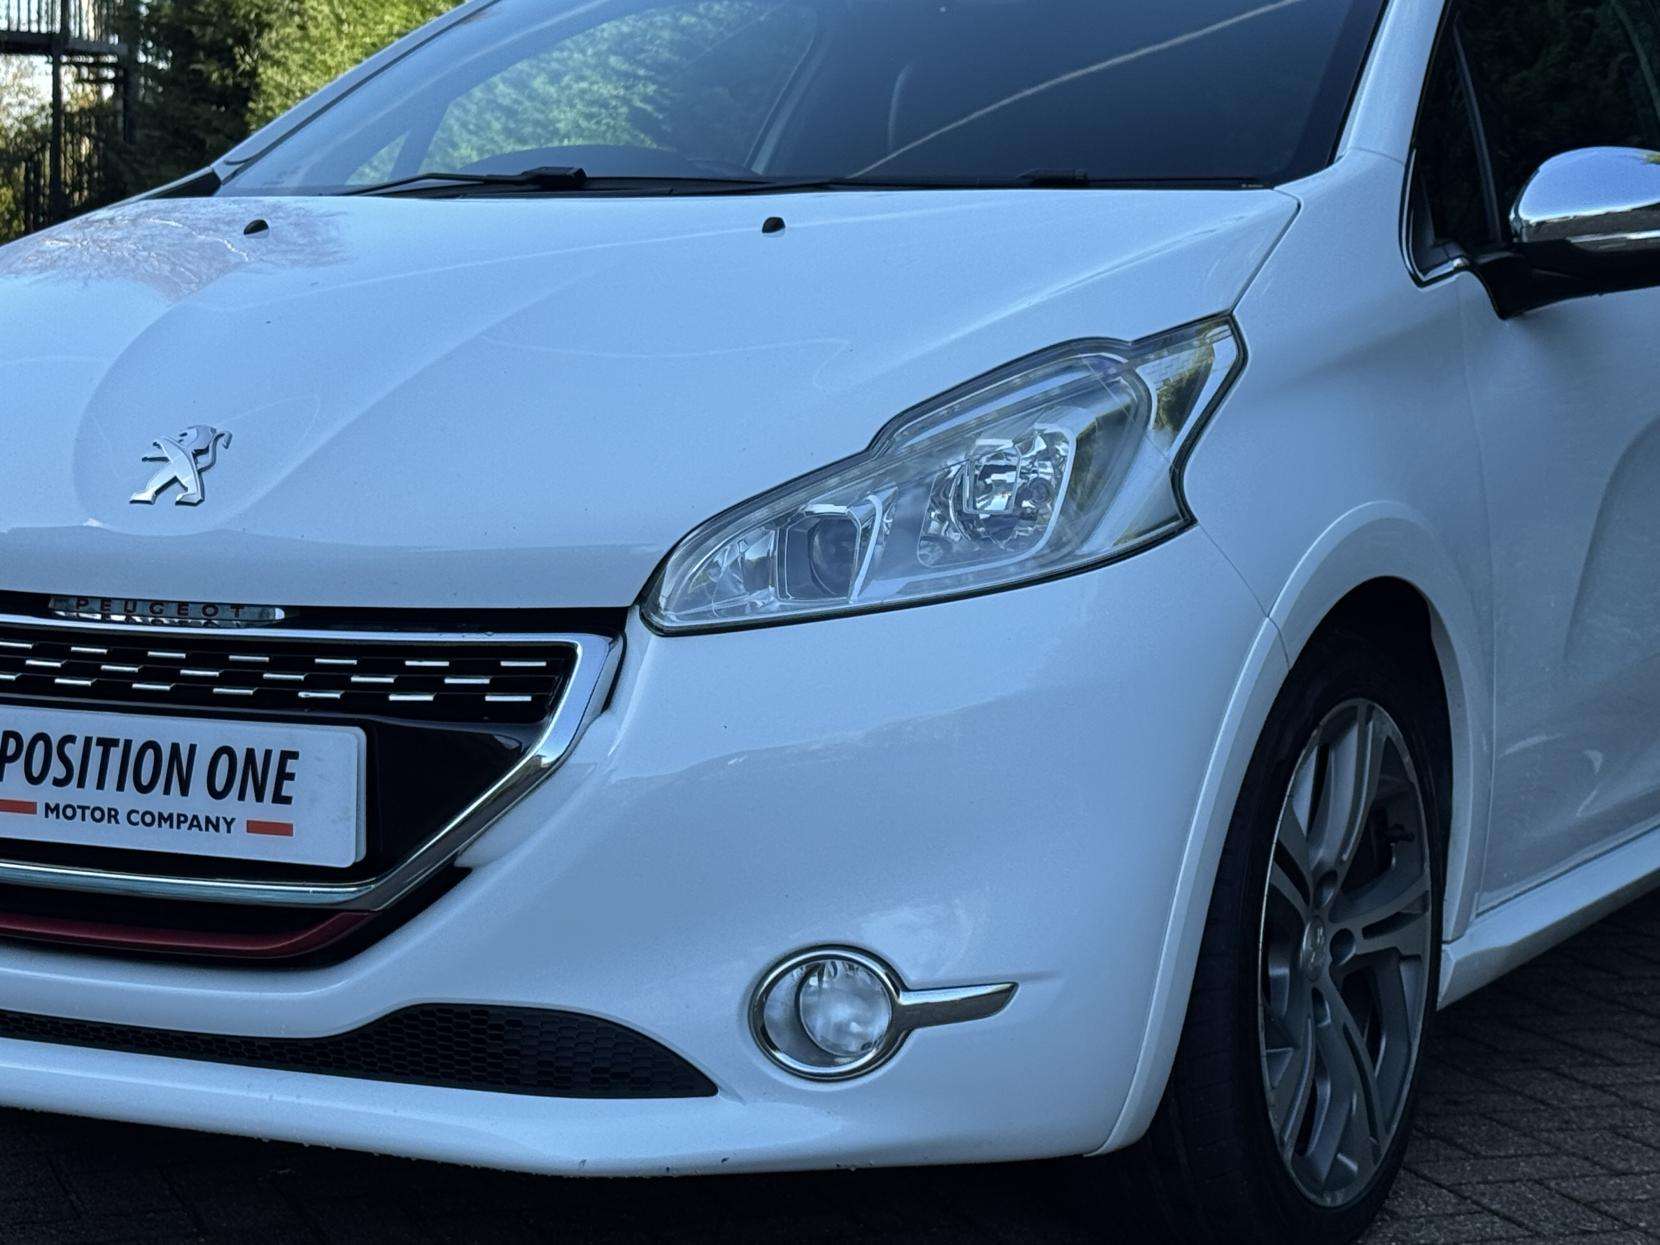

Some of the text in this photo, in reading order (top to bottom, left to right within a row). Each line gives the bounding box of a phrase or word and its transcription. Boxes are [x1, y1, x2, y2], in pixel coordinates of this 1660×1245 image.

[76, 598, 246, 617] PEUGEOT
[0, 730, 300, 805] POSITION ONE
[44, 802, 236, 834] MOTOR COMPANY
